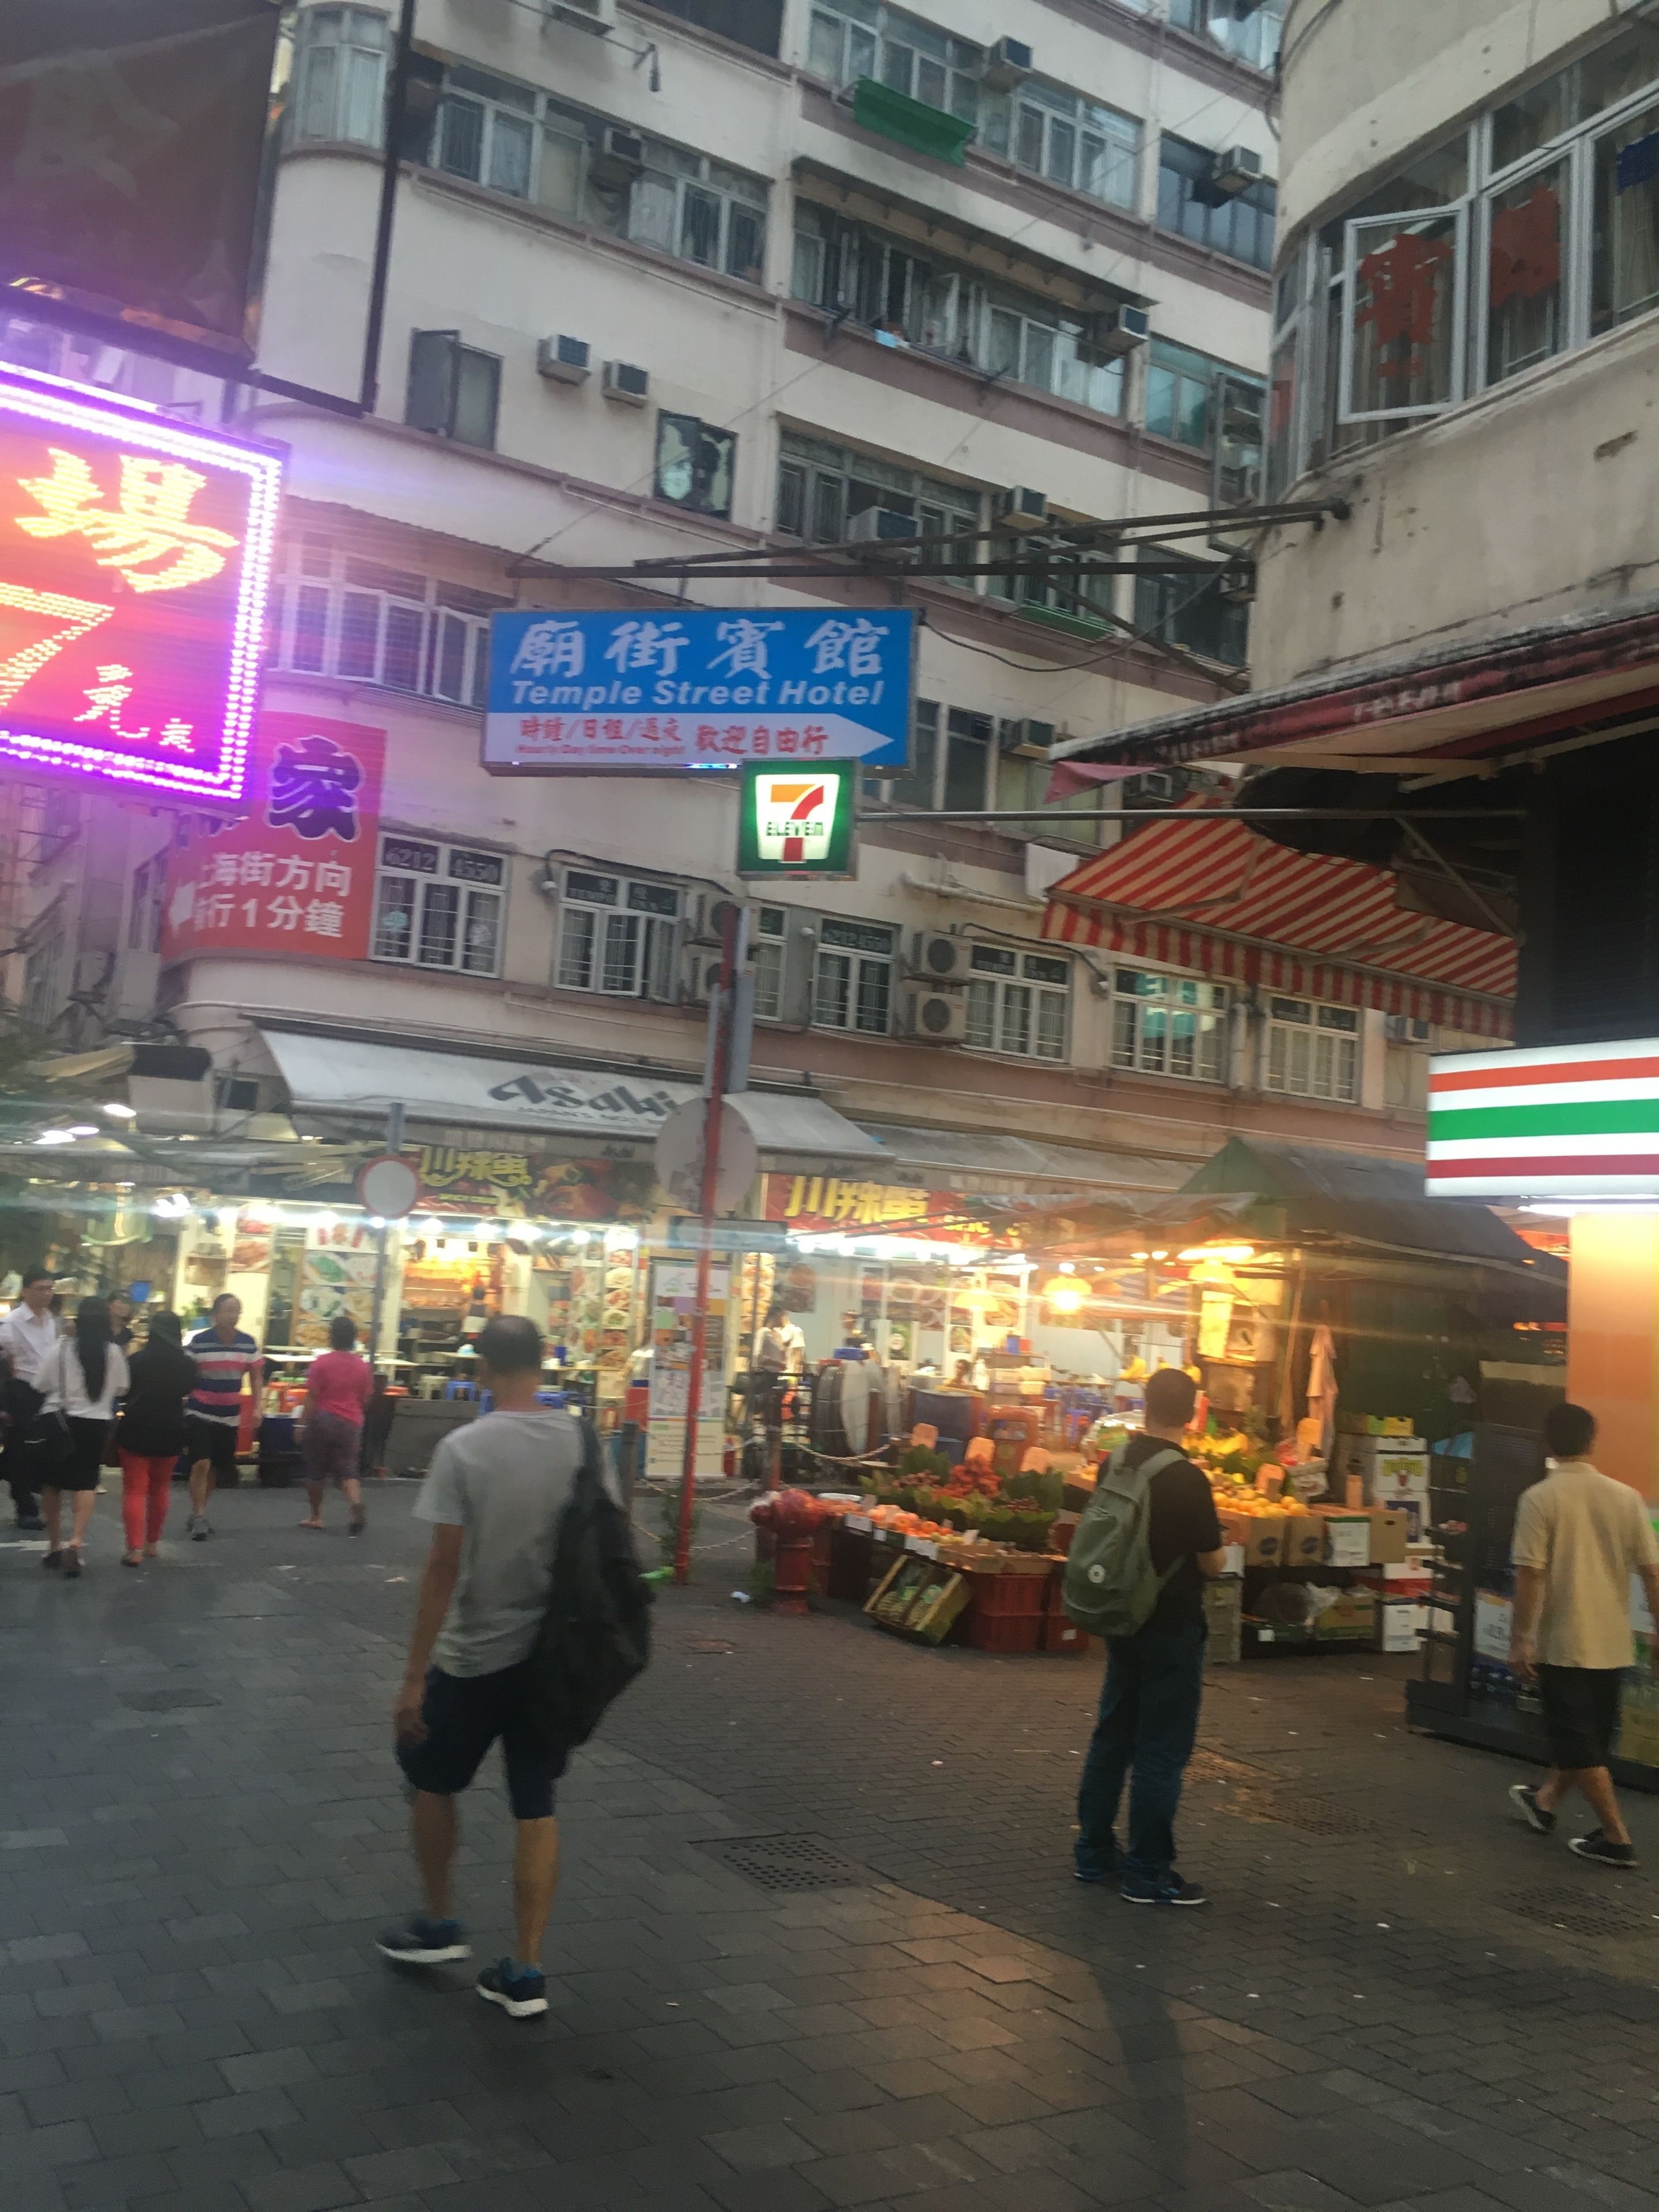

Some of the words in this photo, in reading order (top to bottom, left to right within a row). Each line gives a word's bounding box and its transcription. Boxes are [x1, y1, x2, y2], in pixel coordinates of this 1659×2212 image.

[510, 618, 891, 680] 廟街賓館
[511, 680, 643, 711] Temple
[652, 680, 771, 705] Street
[777, 680, 885, 705] Hotel
